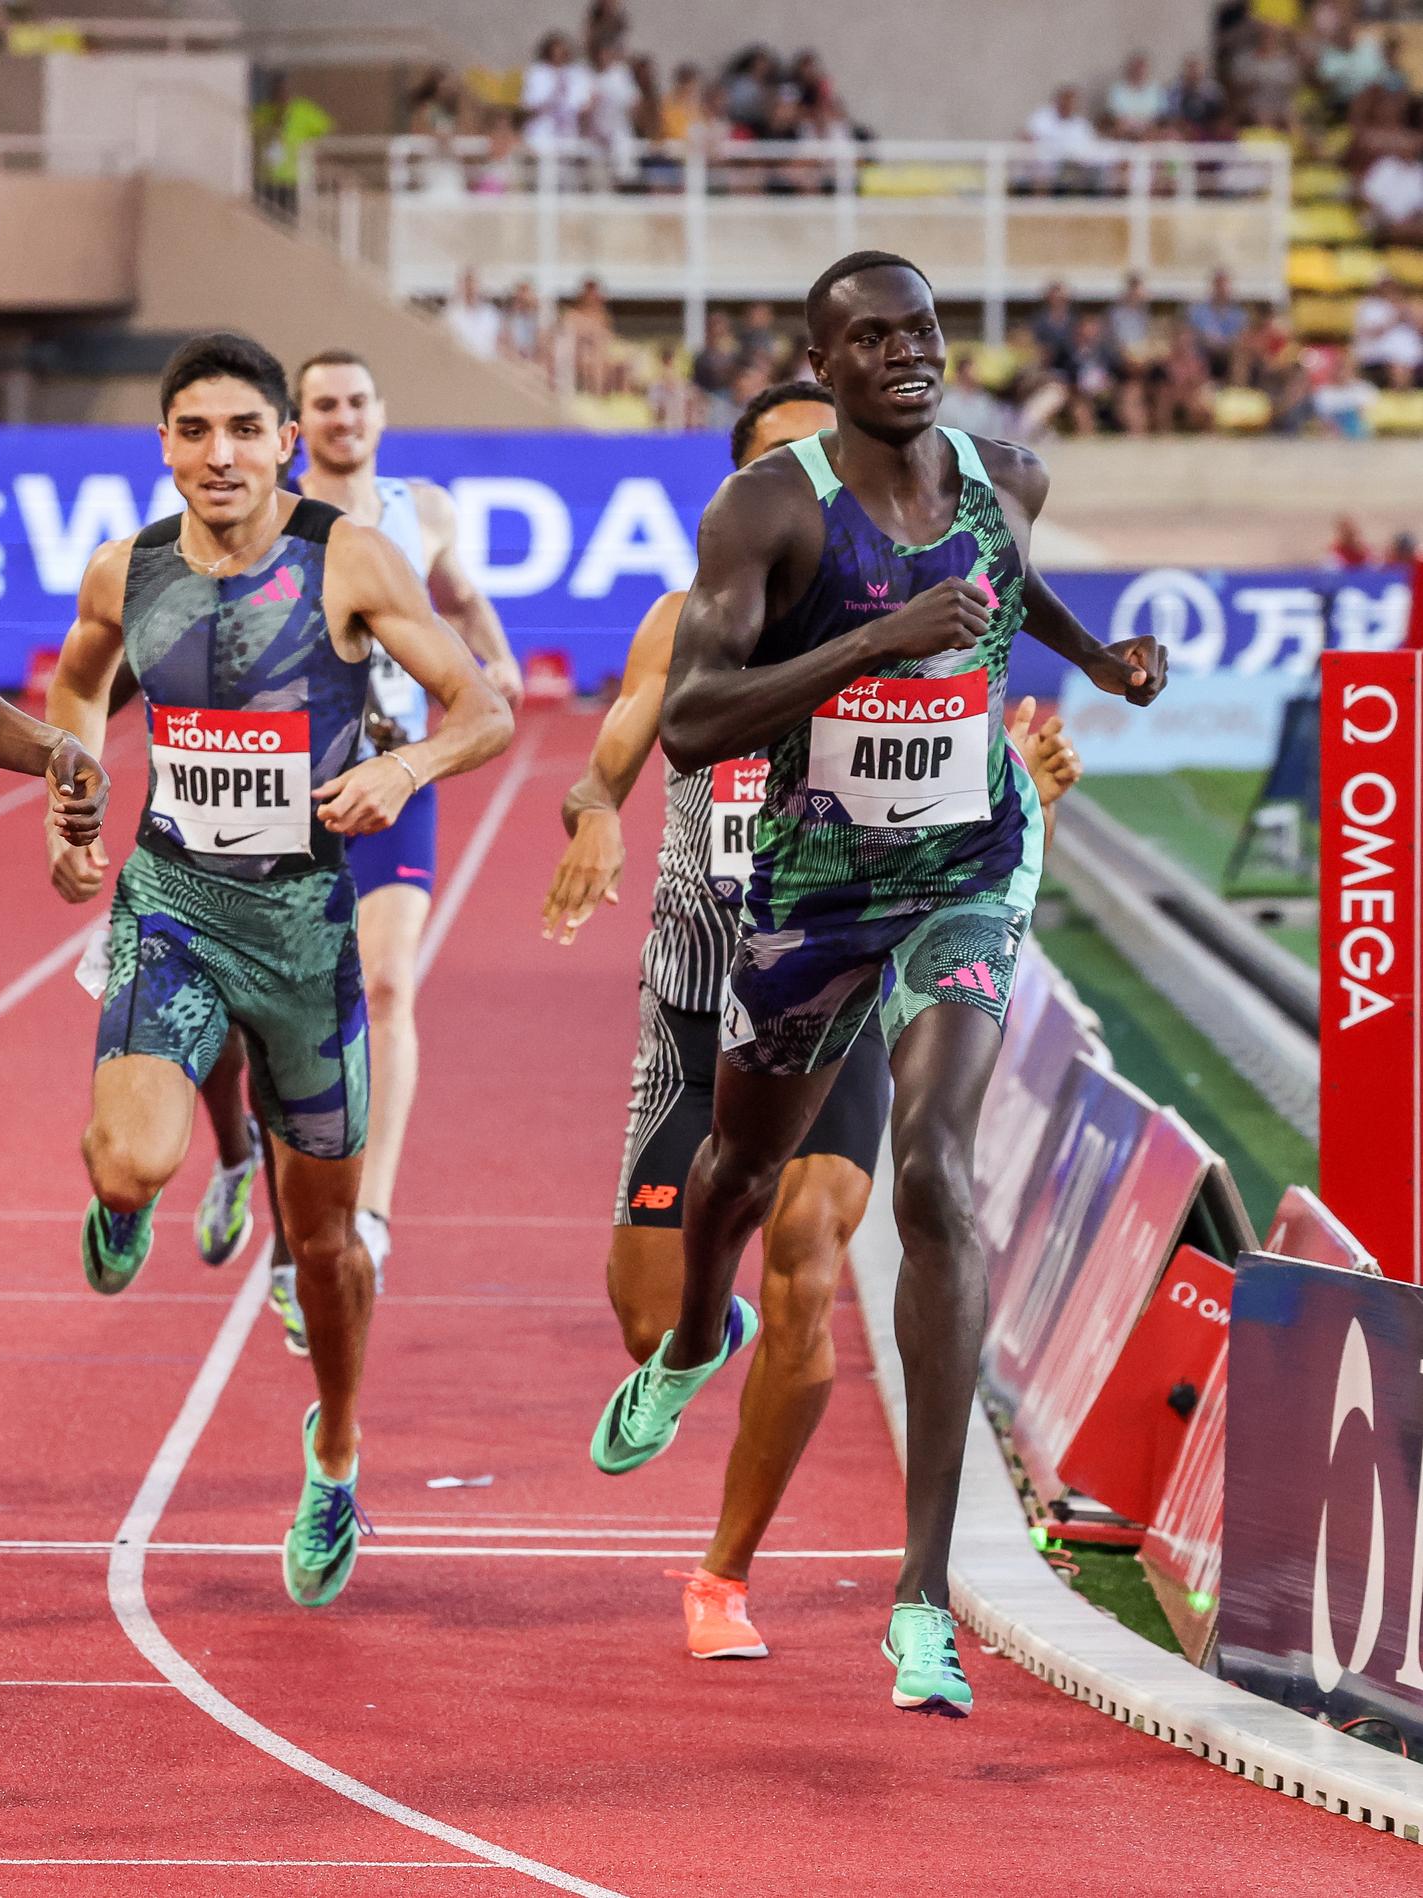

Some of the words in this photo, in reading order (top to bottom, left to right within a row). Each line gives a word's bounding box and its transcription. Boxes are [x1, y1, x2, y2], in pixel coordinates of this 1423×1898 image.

[13, 475, 699, 600] WDA
[166, 711, 202, 727] visit
[837, 695, 965, 721] MONACO
[167, 726, 281, 751] MONACO
[849, 736, 953, 781] AROP
[169, 763, 290, 808] HOPPEL
[1339, 772, 1397, 1030] OMEGA
